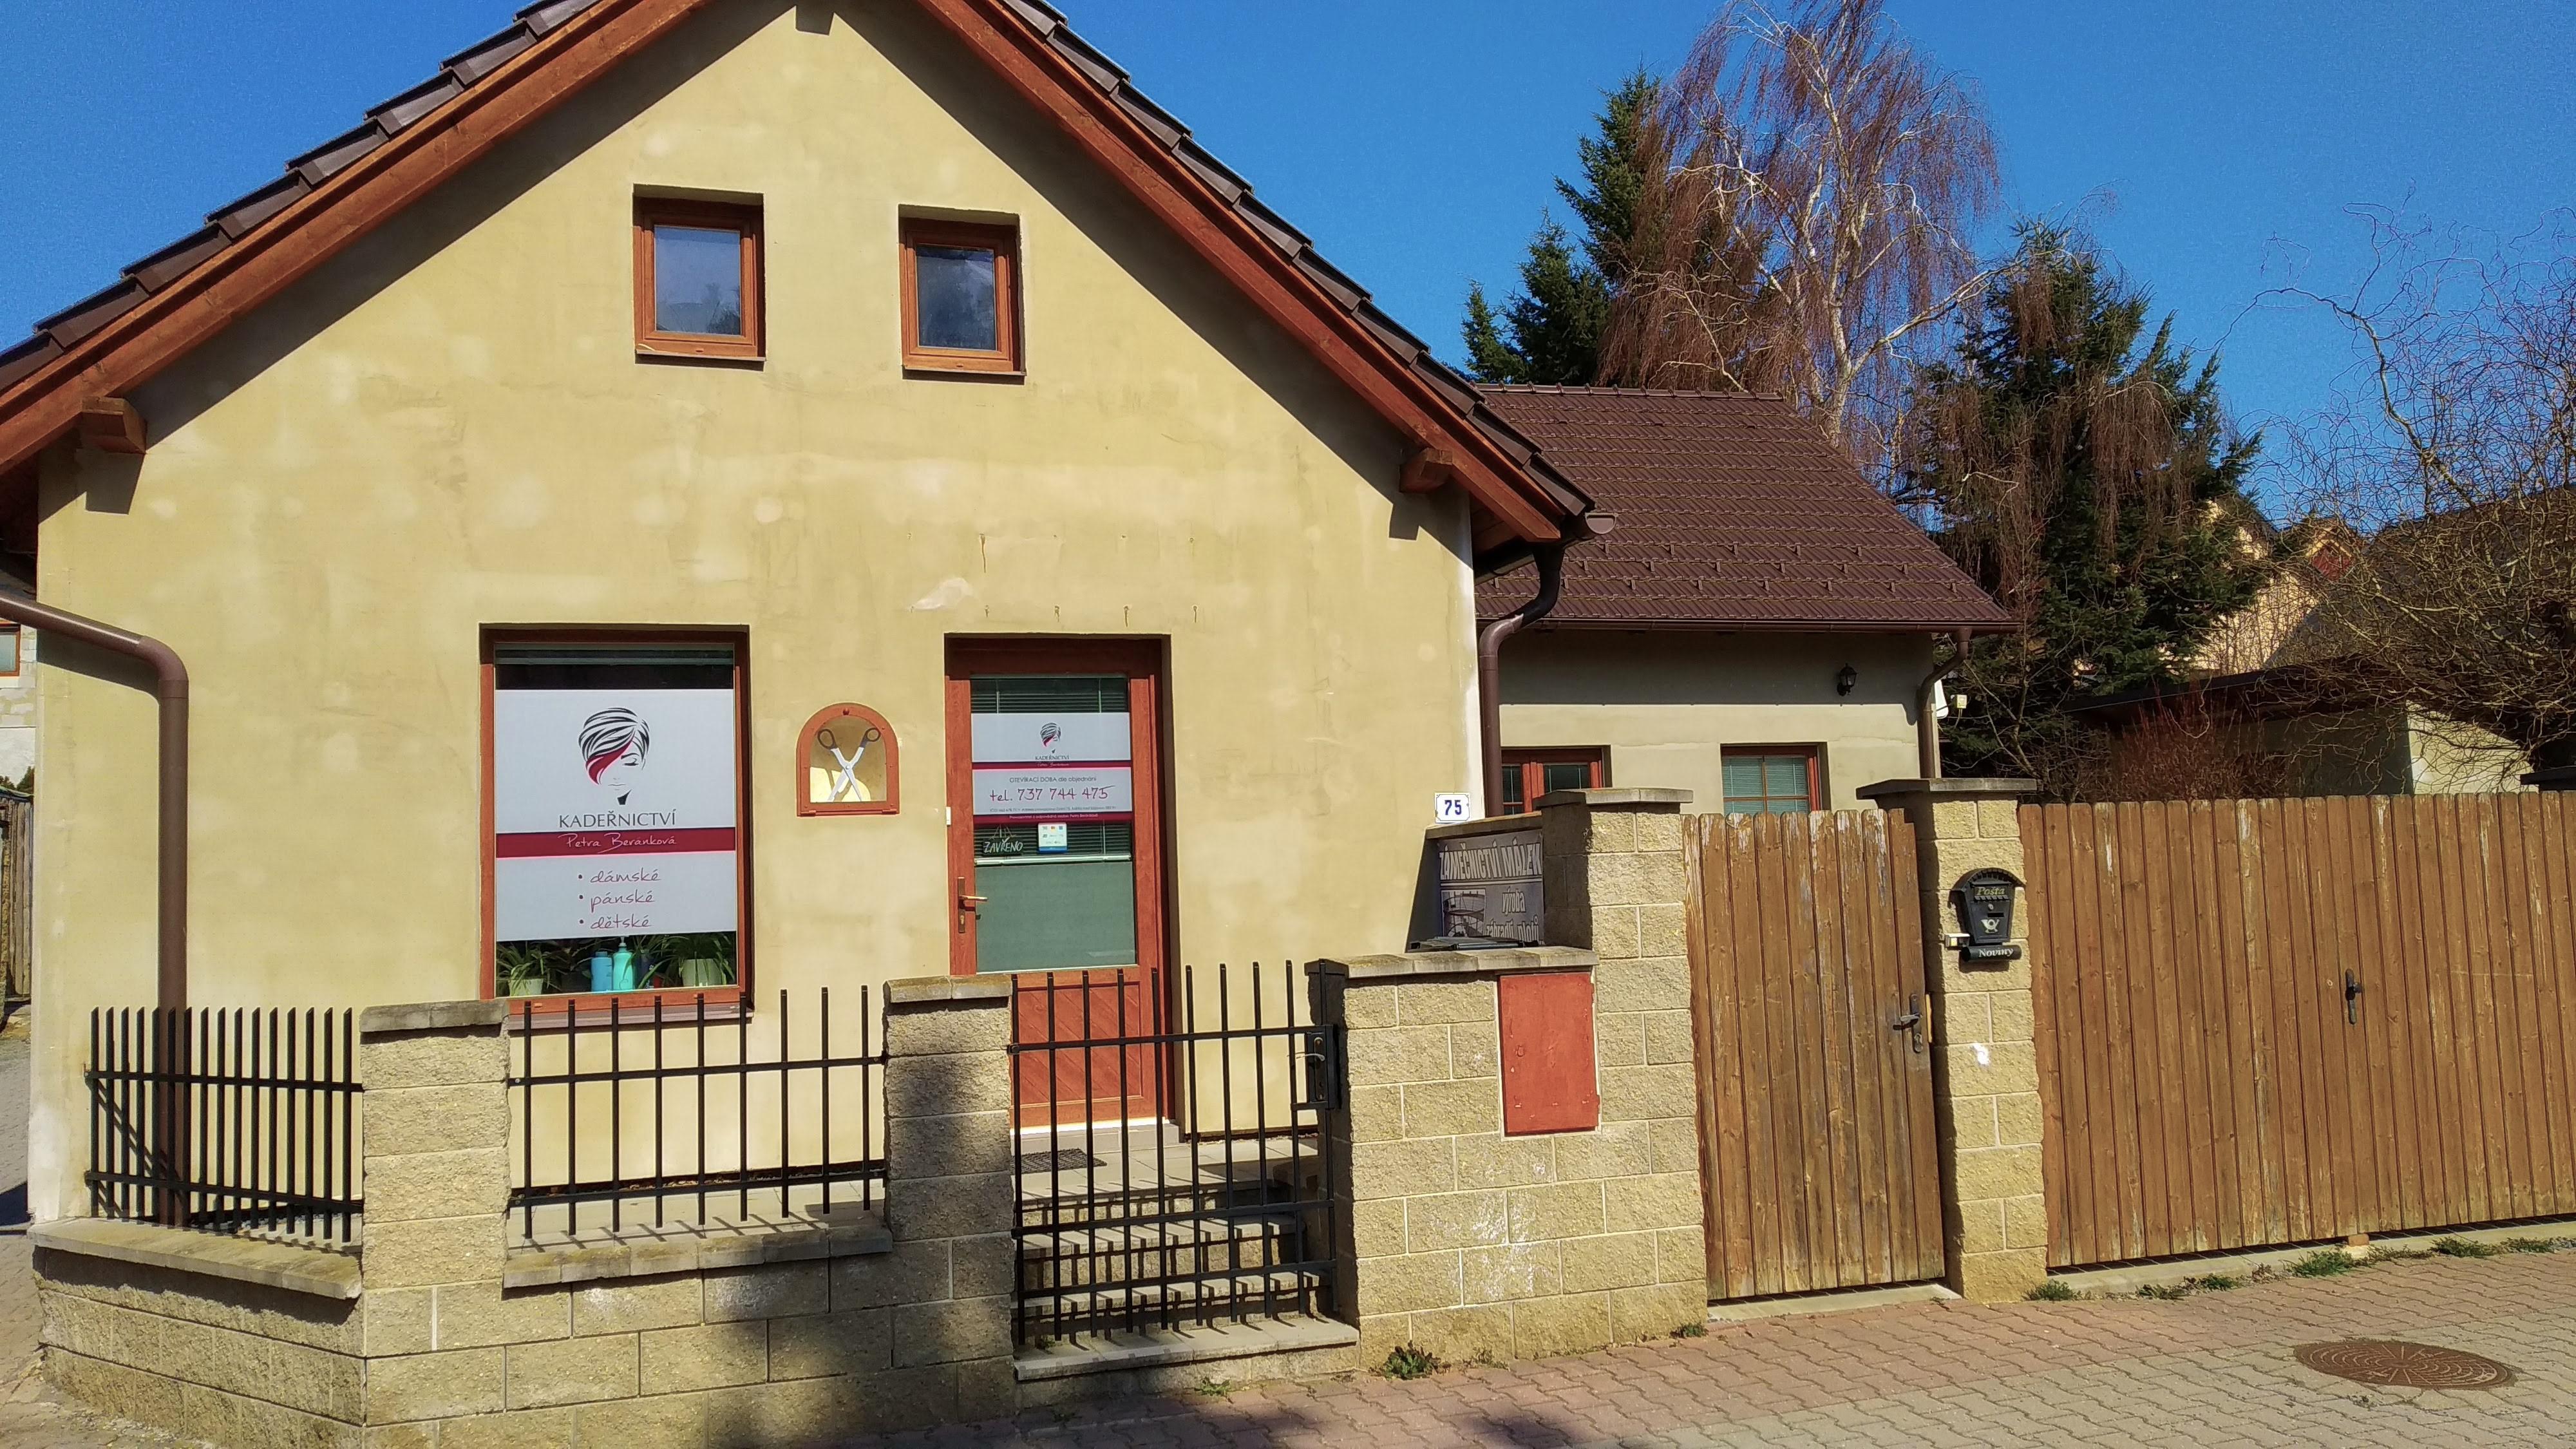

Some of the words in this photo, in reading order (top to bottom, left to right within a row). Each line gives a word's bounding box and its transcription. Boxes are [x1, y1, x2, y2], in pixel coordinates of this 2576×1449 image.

[990, 789, 1013, 802] tel.
[1018, 788, 1043, 801] 737
[1050, 788, 1077, 800] 744
[1082, 785, 1116, 800] 475
[1444, 799, 1463, 816] 75
[559, 808, 677, 828] KADEŘNICTVÍ
[558, 833, 601, 848] Petra
[598, 832, 677, 854] Beránková
[983, 836, 1023, 853] ZAVŘENO
[1439, 838, 1502, 881] ZÁMEČNICTVÍ
[1501, 836, 1543, 878] MÁLEK
[590, 867, 661, 884] dámské
[1975, 886, 2005, 896] Pošta
[590, 889, 656, 913] pánské
[1502, 886, 1526, 916] výroba
[590, 913, 652, 929] dětské
[1978, 947, 2014, 958] Noviny
